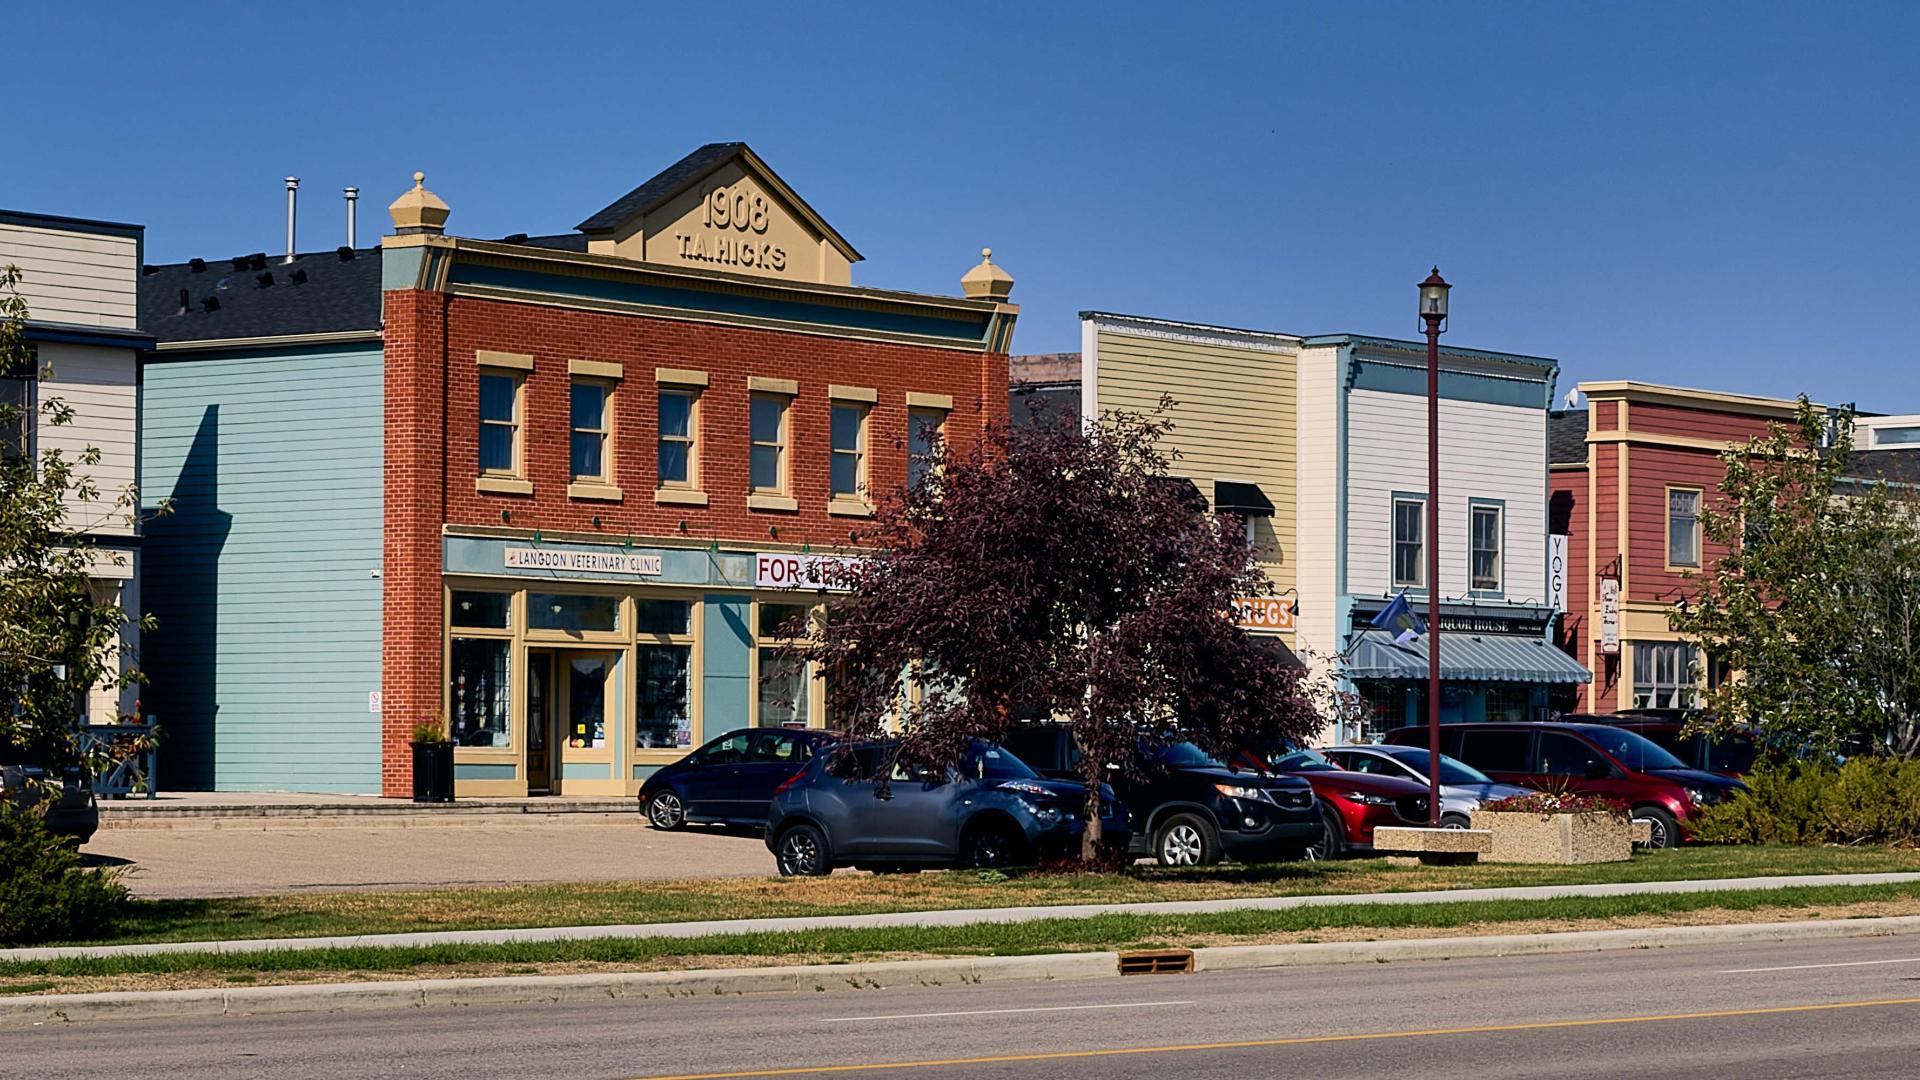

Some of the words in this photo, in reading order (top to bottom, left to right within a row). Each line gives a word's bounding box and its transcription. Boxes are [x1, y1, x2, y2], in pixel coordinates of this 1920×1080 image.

[703, 186, 769, 234] 1908
[519, 551, 567, 566] LANGDON
[570, 554, 626, 570] VETERINARY
[630, 557, 660, 572] CLINIC
[758, 558, 800, 583] FOR
[1552, 537, 1562, 610] YOGA
[1438, 617, 1472, 630] IQUOR
[1474, 618, 1509, 632] HOUSE
